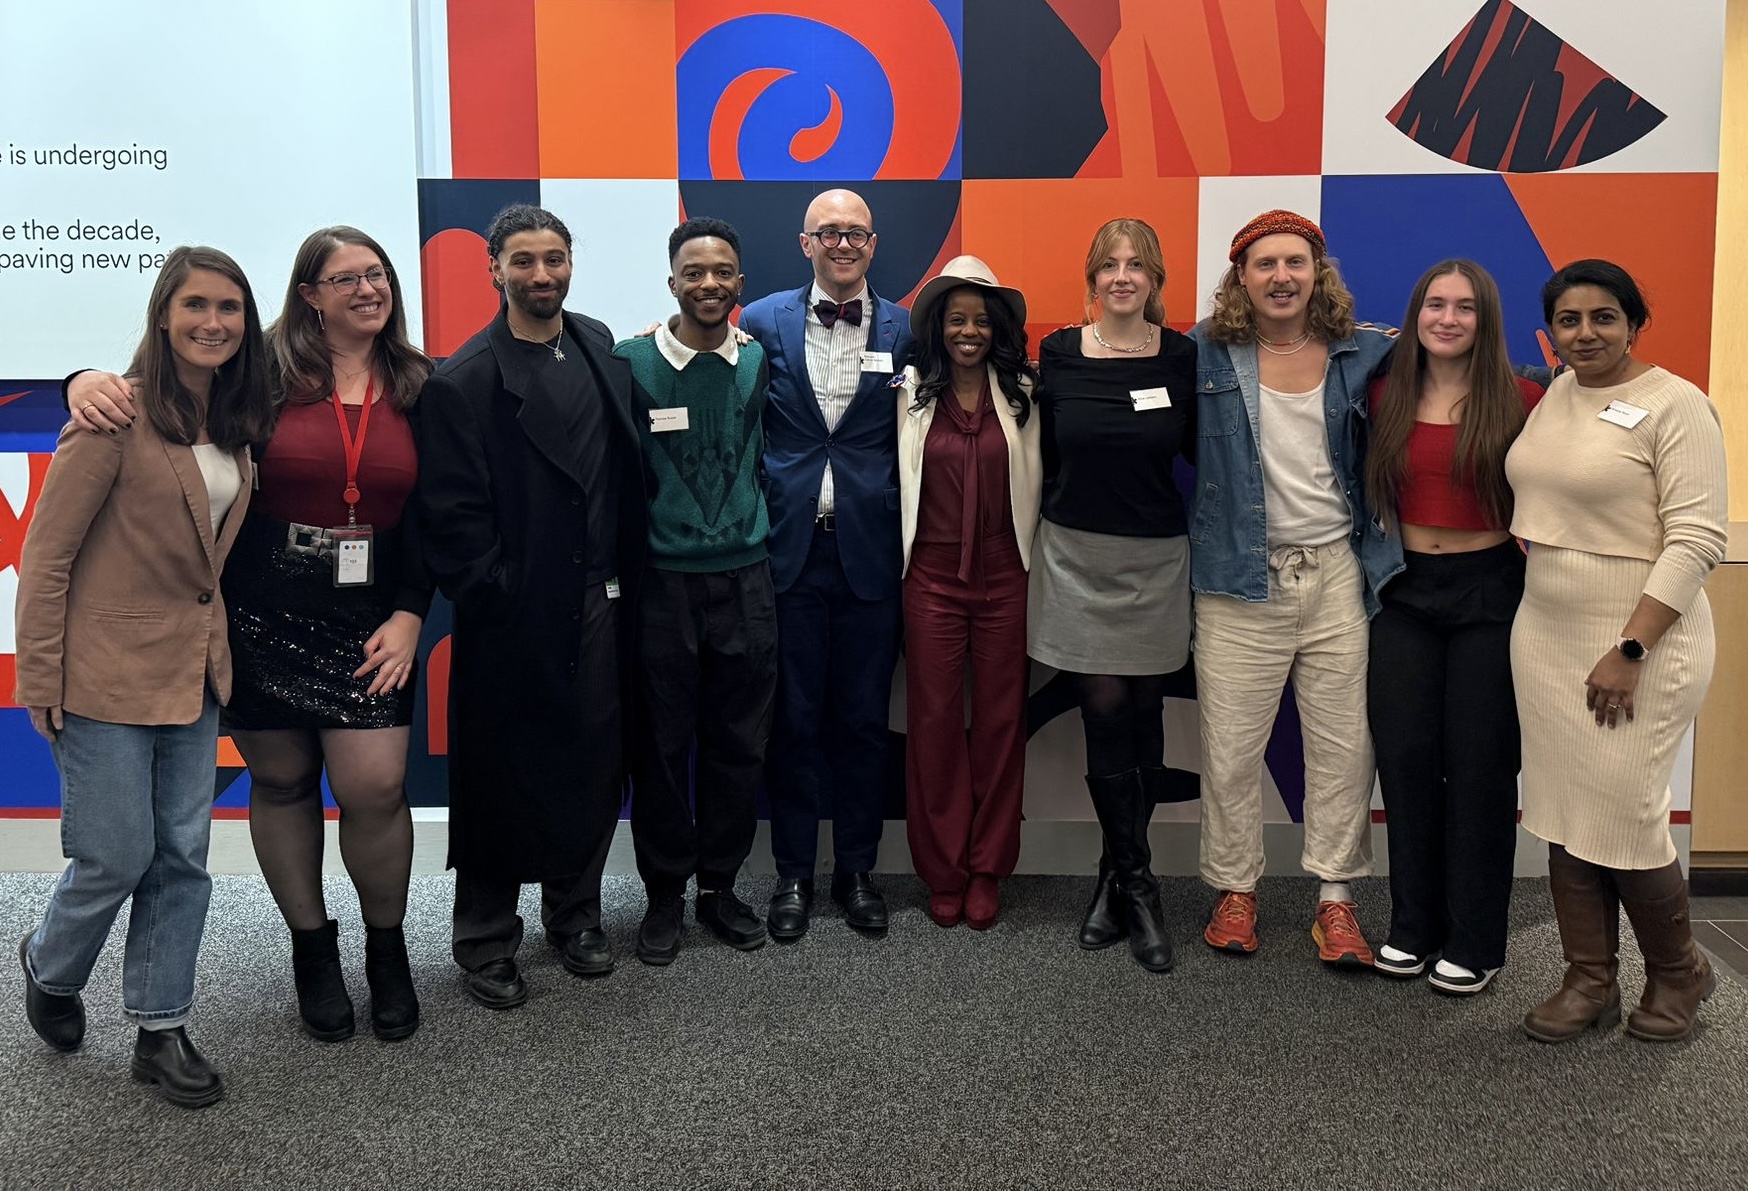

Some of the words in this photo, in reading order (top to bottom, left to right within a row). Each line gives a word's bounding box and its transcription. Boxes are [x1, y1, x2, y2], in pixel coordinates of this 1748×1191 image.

[9, 143, 27, 165] is
[34, 143, 168, 171] undergoing
[22, 218, 60, 241] the
[67, 218, 161, 245] decade,
[0, 247, 74, 274] paving
[82, 253, 131, 269] new
[138, 250, 171, 274] pa
